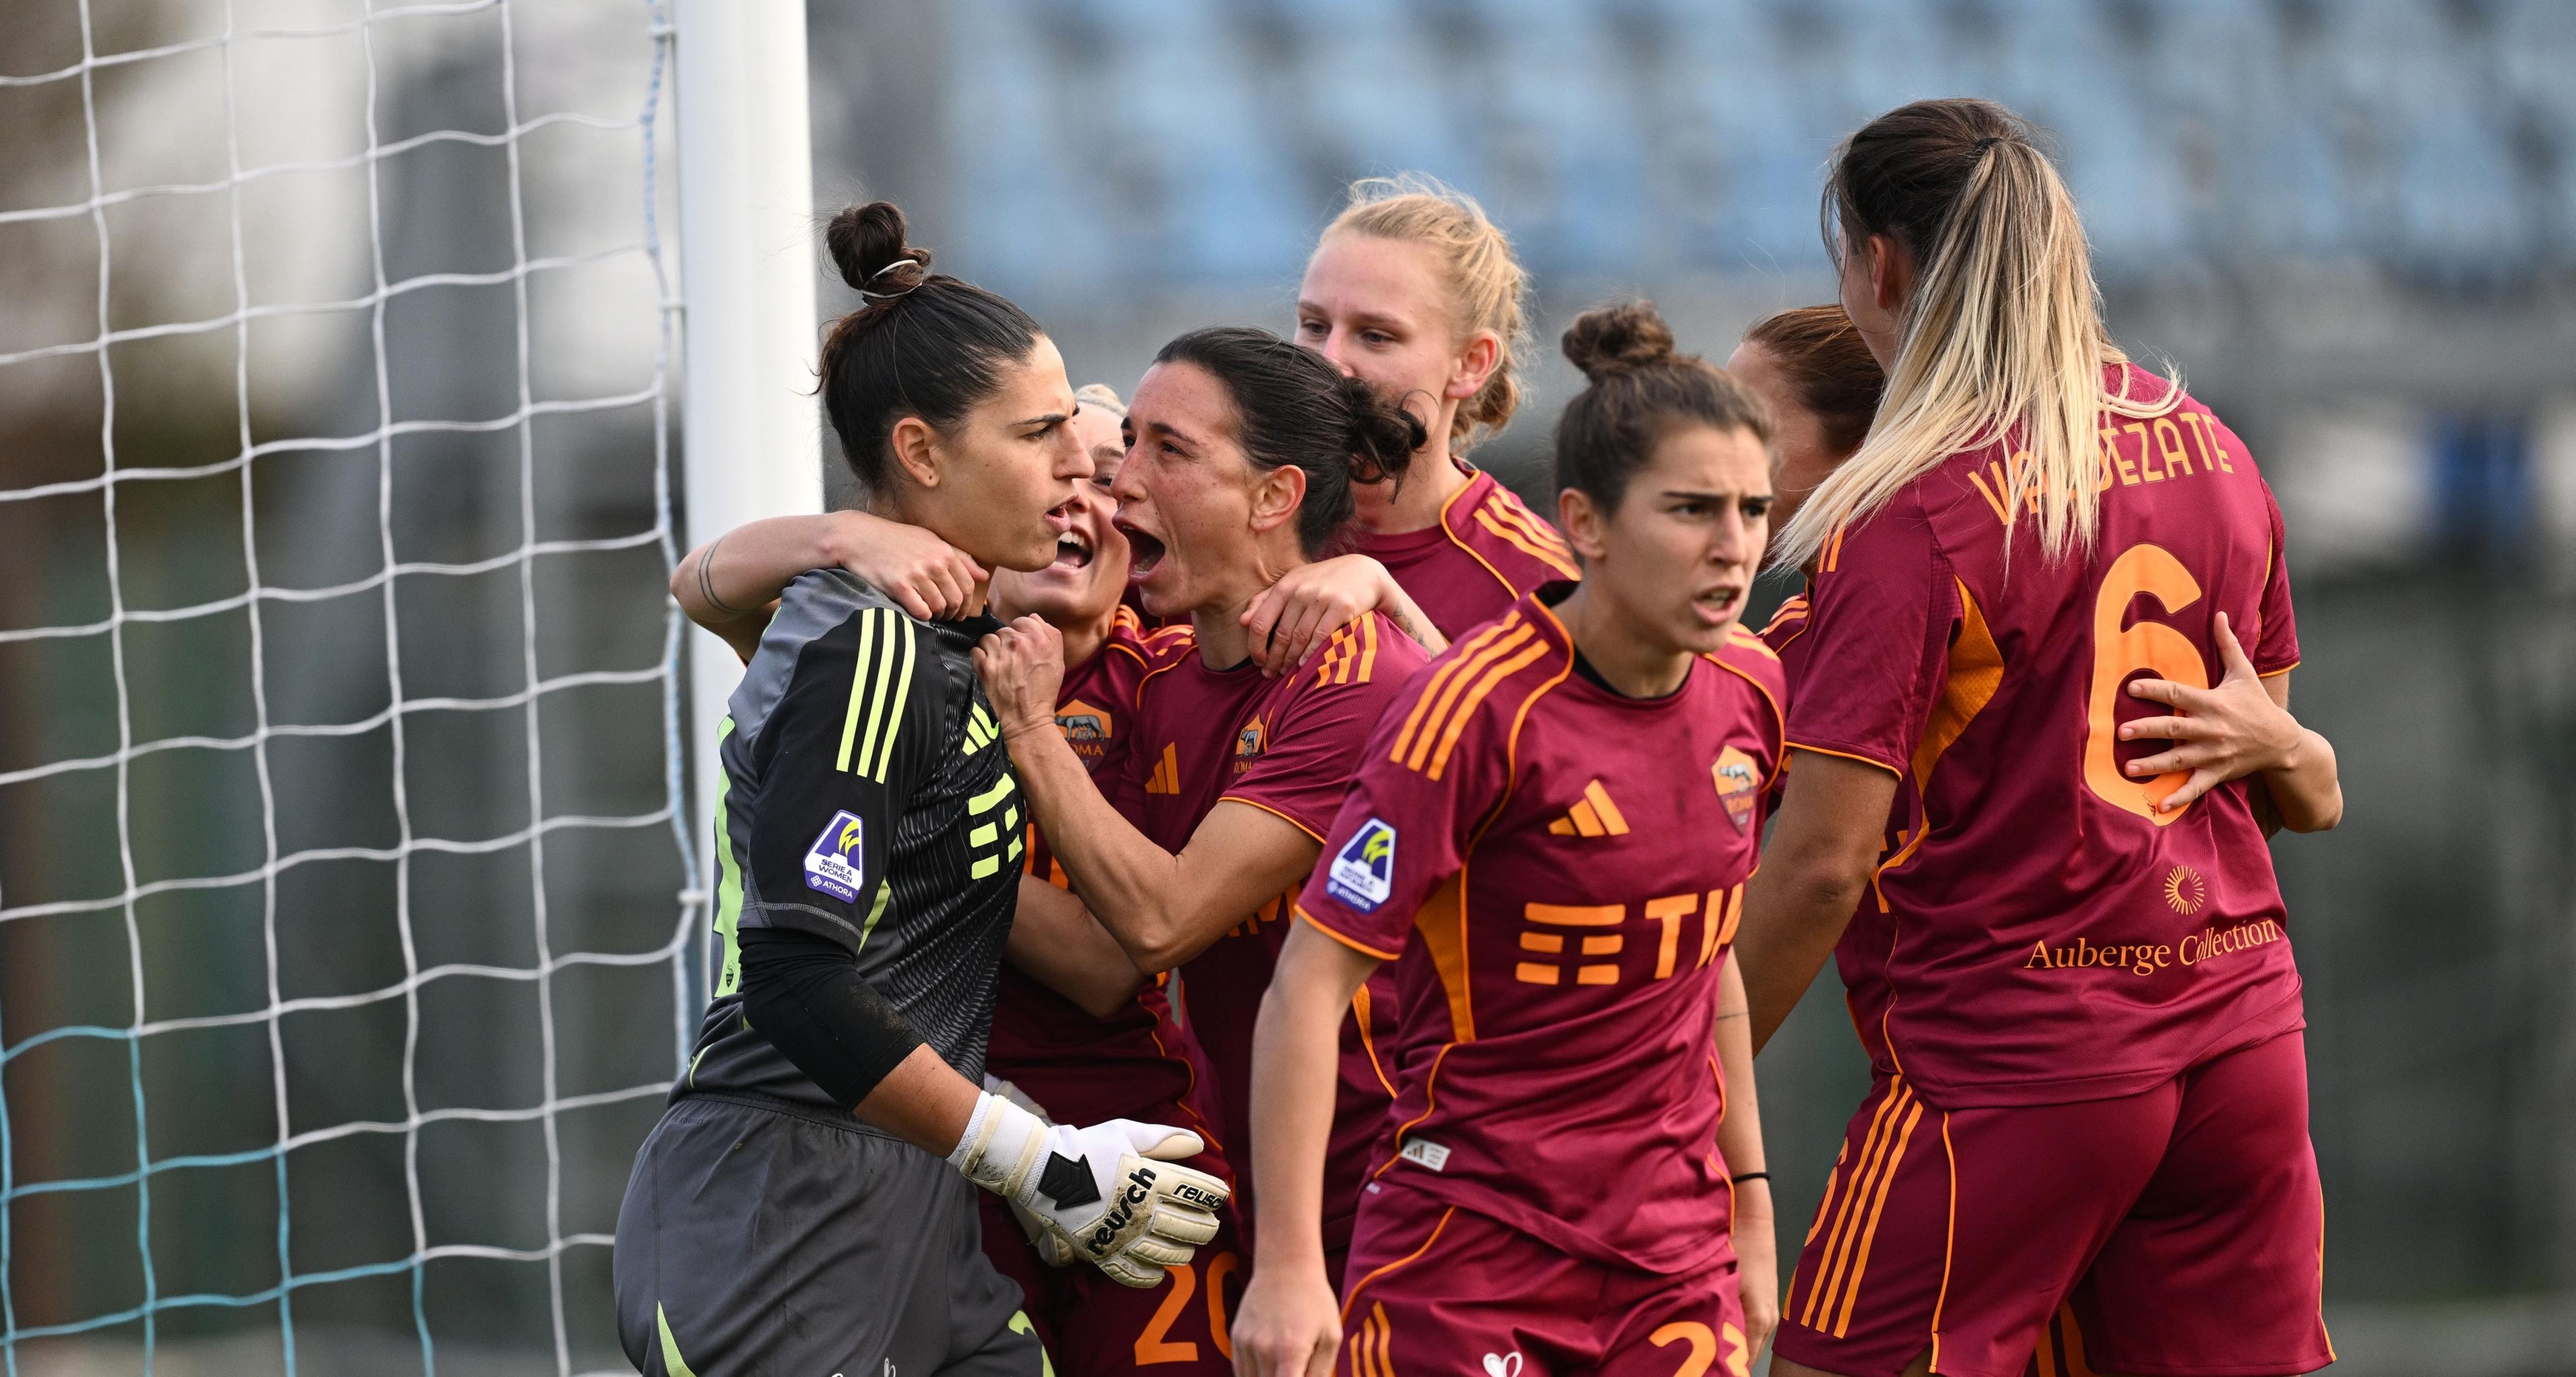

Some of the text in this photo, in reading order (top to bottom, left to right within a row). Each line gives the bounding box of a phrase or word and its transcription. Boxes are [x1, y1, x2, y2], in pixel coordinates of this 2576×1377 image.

[2084, 543, 2208, 826] 6
[1071, 744, 1104, 757] OMA
[818, 865, 853, 883] WOMEN
[821, 859, 845, 873] SERIE
[823, 881, 853, 898] ATHORA
[2023, 918, 2279, 976] Auberge Collection
[1087, 1167, 1157, 1255] reusch
